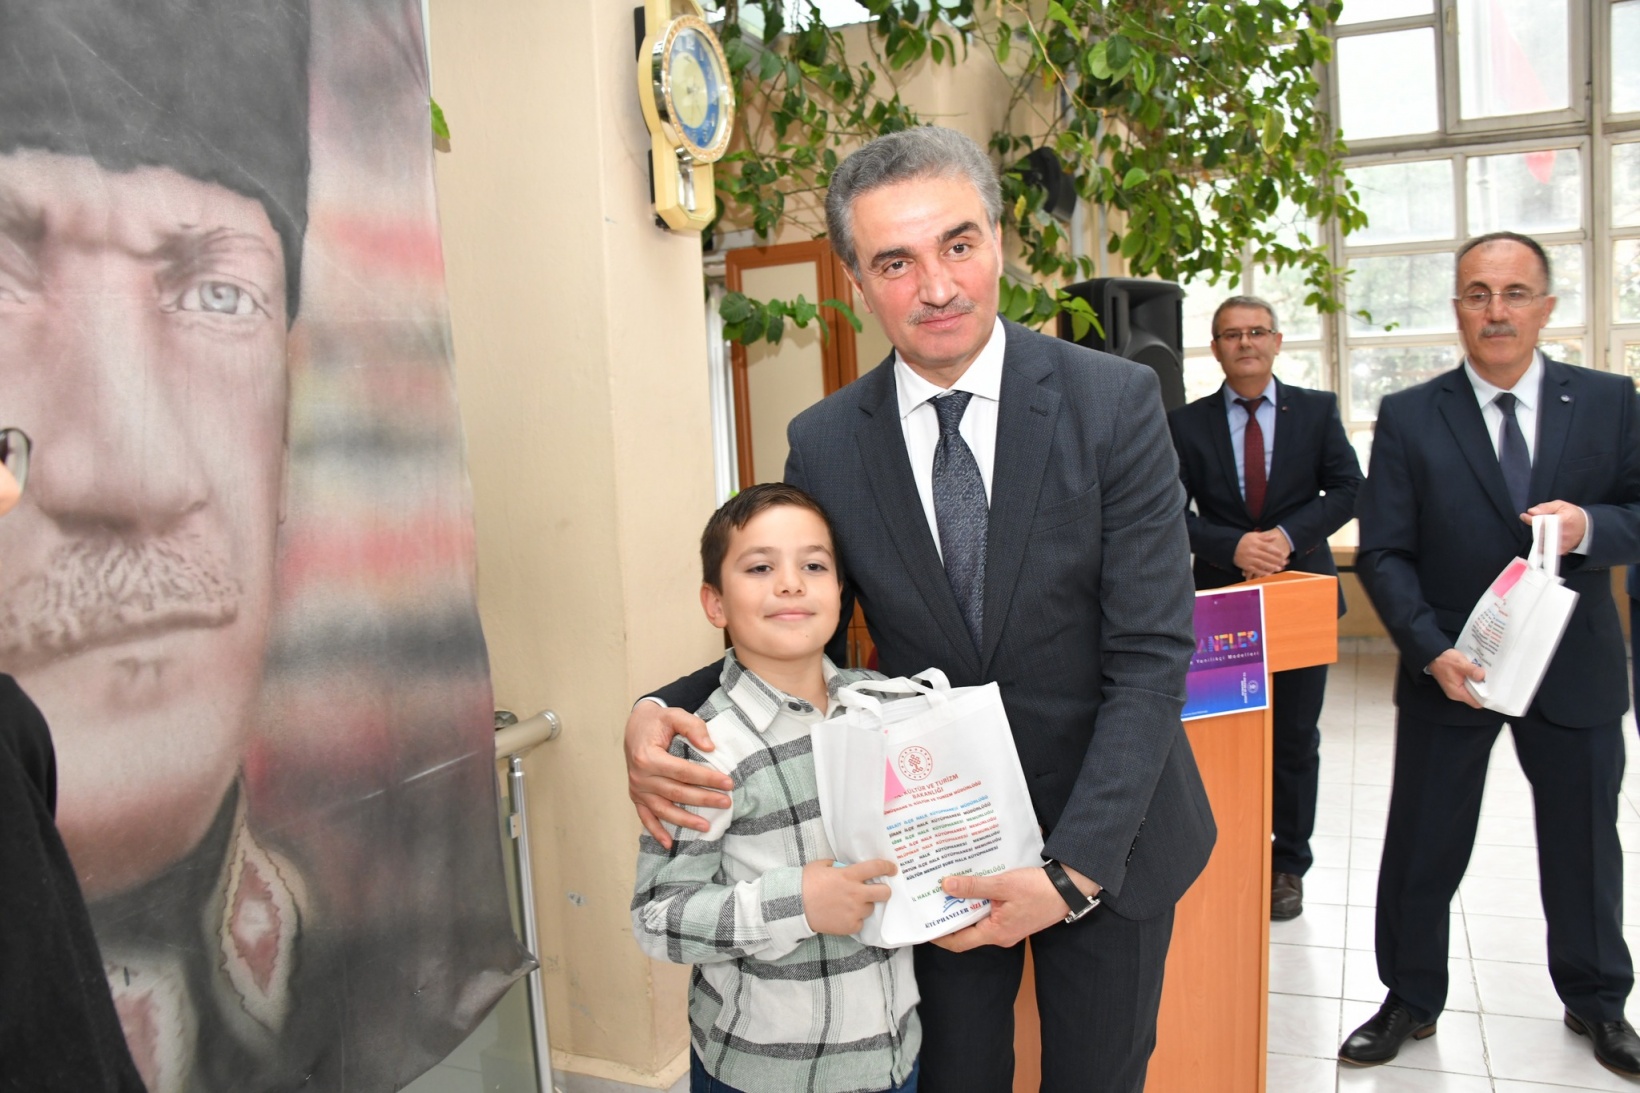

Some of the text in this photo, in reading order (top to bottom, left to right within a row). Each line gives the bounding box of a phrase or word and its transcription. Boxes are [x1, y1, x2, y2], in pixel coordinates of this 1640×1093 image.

[904, 785, 926, 795] KÜLTÜR
[935, 773, 959, 786] TURİZM
[912, 787, 944, 799] BAKANLIĞI
[973, 864, 1006, 877] ÜDÜRLÜĞÜ
